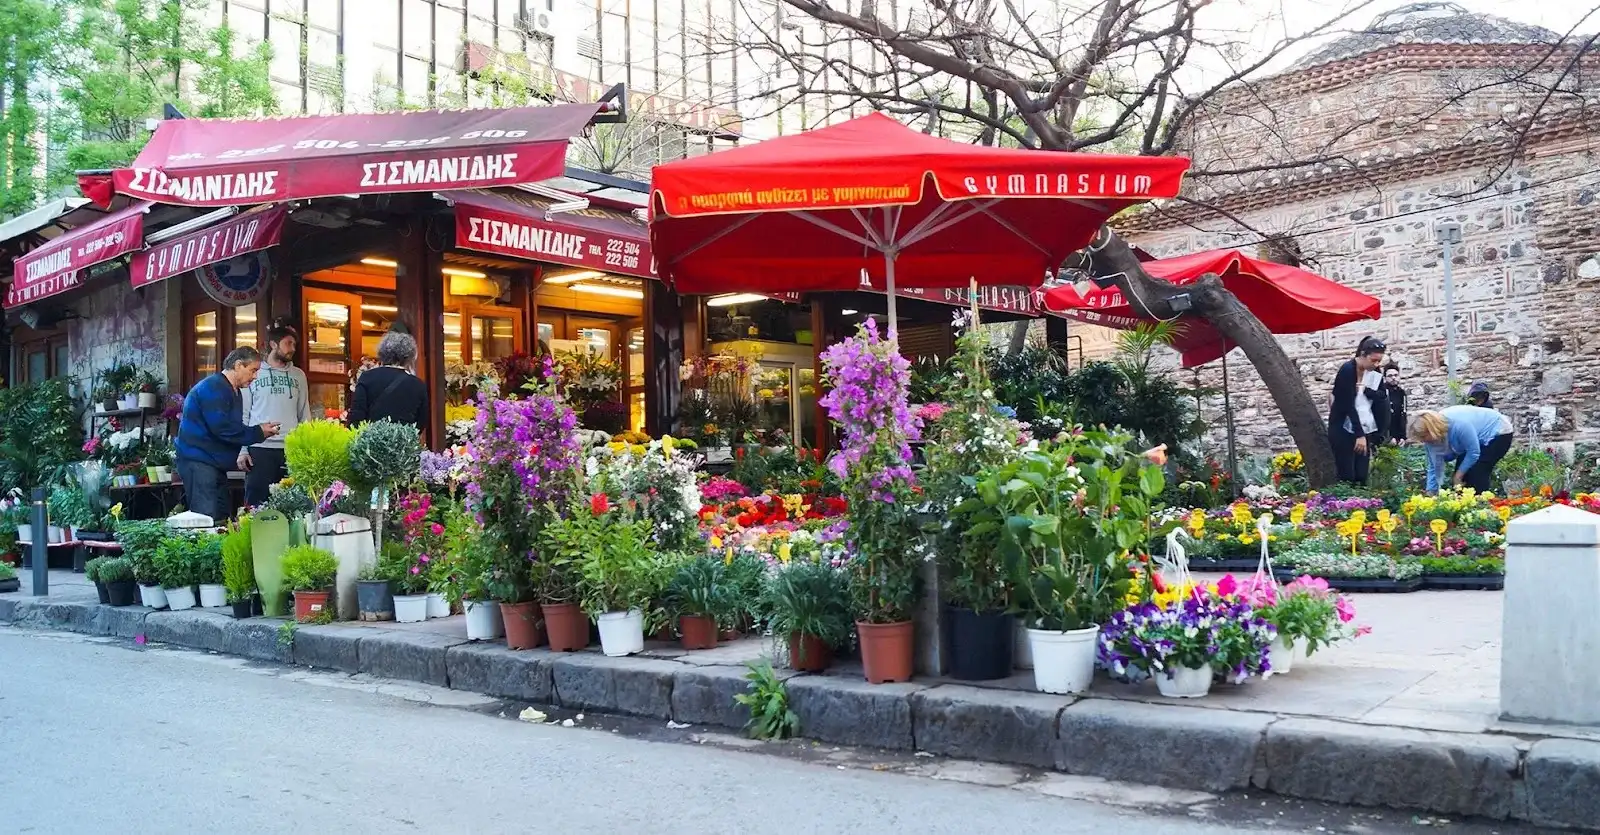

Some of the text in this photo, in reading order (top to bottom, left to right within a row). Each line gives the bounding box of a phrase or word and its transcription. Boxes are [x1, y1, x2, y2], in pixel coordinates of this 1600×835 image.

[460, 129, 528, 139] 506
[361, 153, 518, 187] ΣΙΣΜΑΝΙΔΗΣ
[128, 167, 278, 201] ΣΙΣΜΑΝΙΔΗΣ
[964, 173, 1152, 195] GYMNASIUM
[757, 188, 807, 207] ανθίζει
[812, 188, 830, 205] με
[468, 217, 587, 260] ΣΙΣΜΑΝΙΔΗΣ
[606, 239, 640, 255] 222 504
[145, 219, 260, 281] GYMNASIUM
[605, 252, 621, 266] 222
[622, 256, 639, 269] 506
